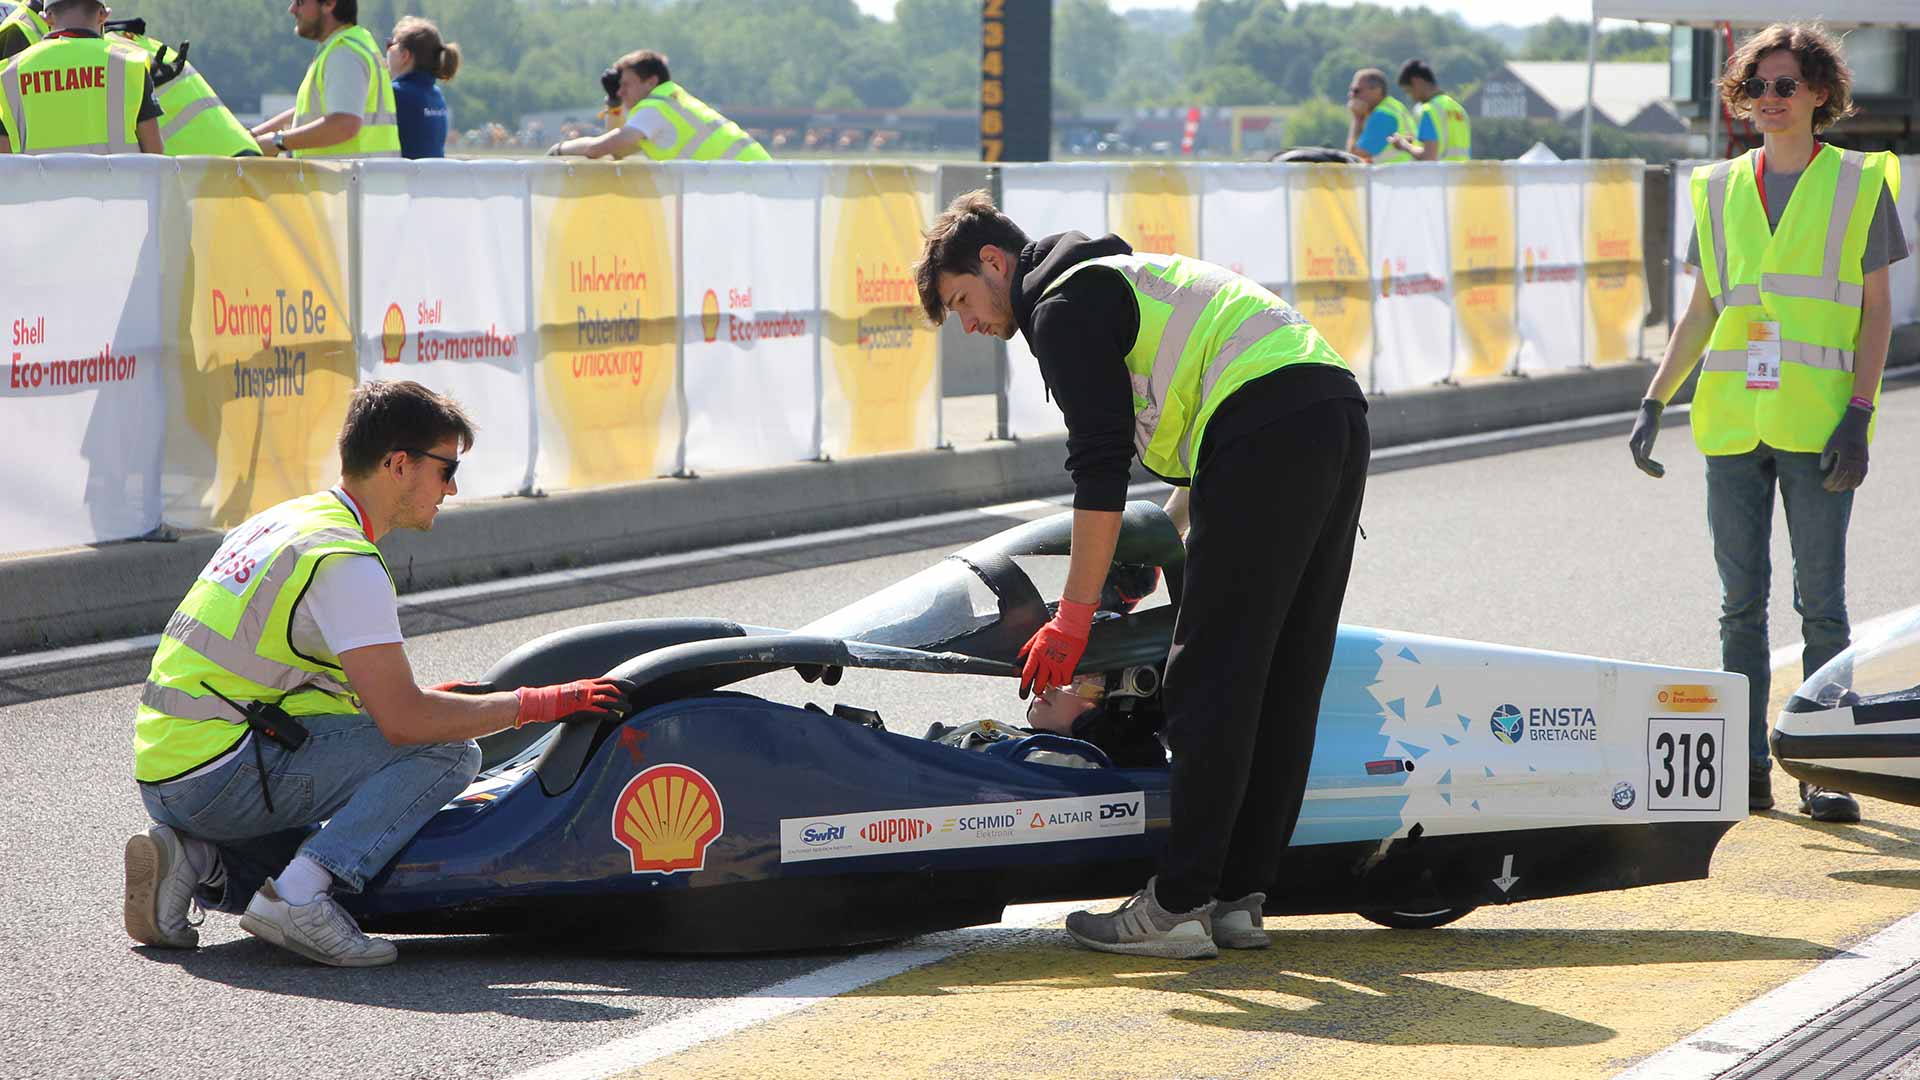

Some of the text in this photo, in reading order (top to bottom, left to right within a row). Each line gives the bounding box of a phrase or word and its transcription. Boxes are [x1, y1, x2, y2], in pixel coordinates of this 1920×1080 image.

[984, 22, 1005, 47] 3
[983, 51, 1004, 76] 4
[20, 66, 105, 95] PITLANE
[983, 80, 1004, 105] 5
[982, 111, 1003, 134] 6
[982, 139, 1004, 162] 7
[212, 288, 327, 350] Daring To Be
[417, 299, 442, 325] Shell
[577, 299, 641, 346] Potential
[13, 317, 45, 346] Shell
[417, 323, 518, 363] Eco-marathon
[11, 343, 137, 389] Eco-marathon
[1529, 708, 1597, 727] ENSTA
[1530, 729, 1597, 741] BRETAGNE
[1655, 732, 1716, 799] 318
[959, 815, 1015, 831] SCHMID
[1049, 811, 1093, 825] ALTAIR
[1099, 801, 1140, 820] DSV
[803, 826, 846, 843] SwRI
[869, 818, 925, 844] DUPONT
[976, 829, 1014, 839] Elektronik
